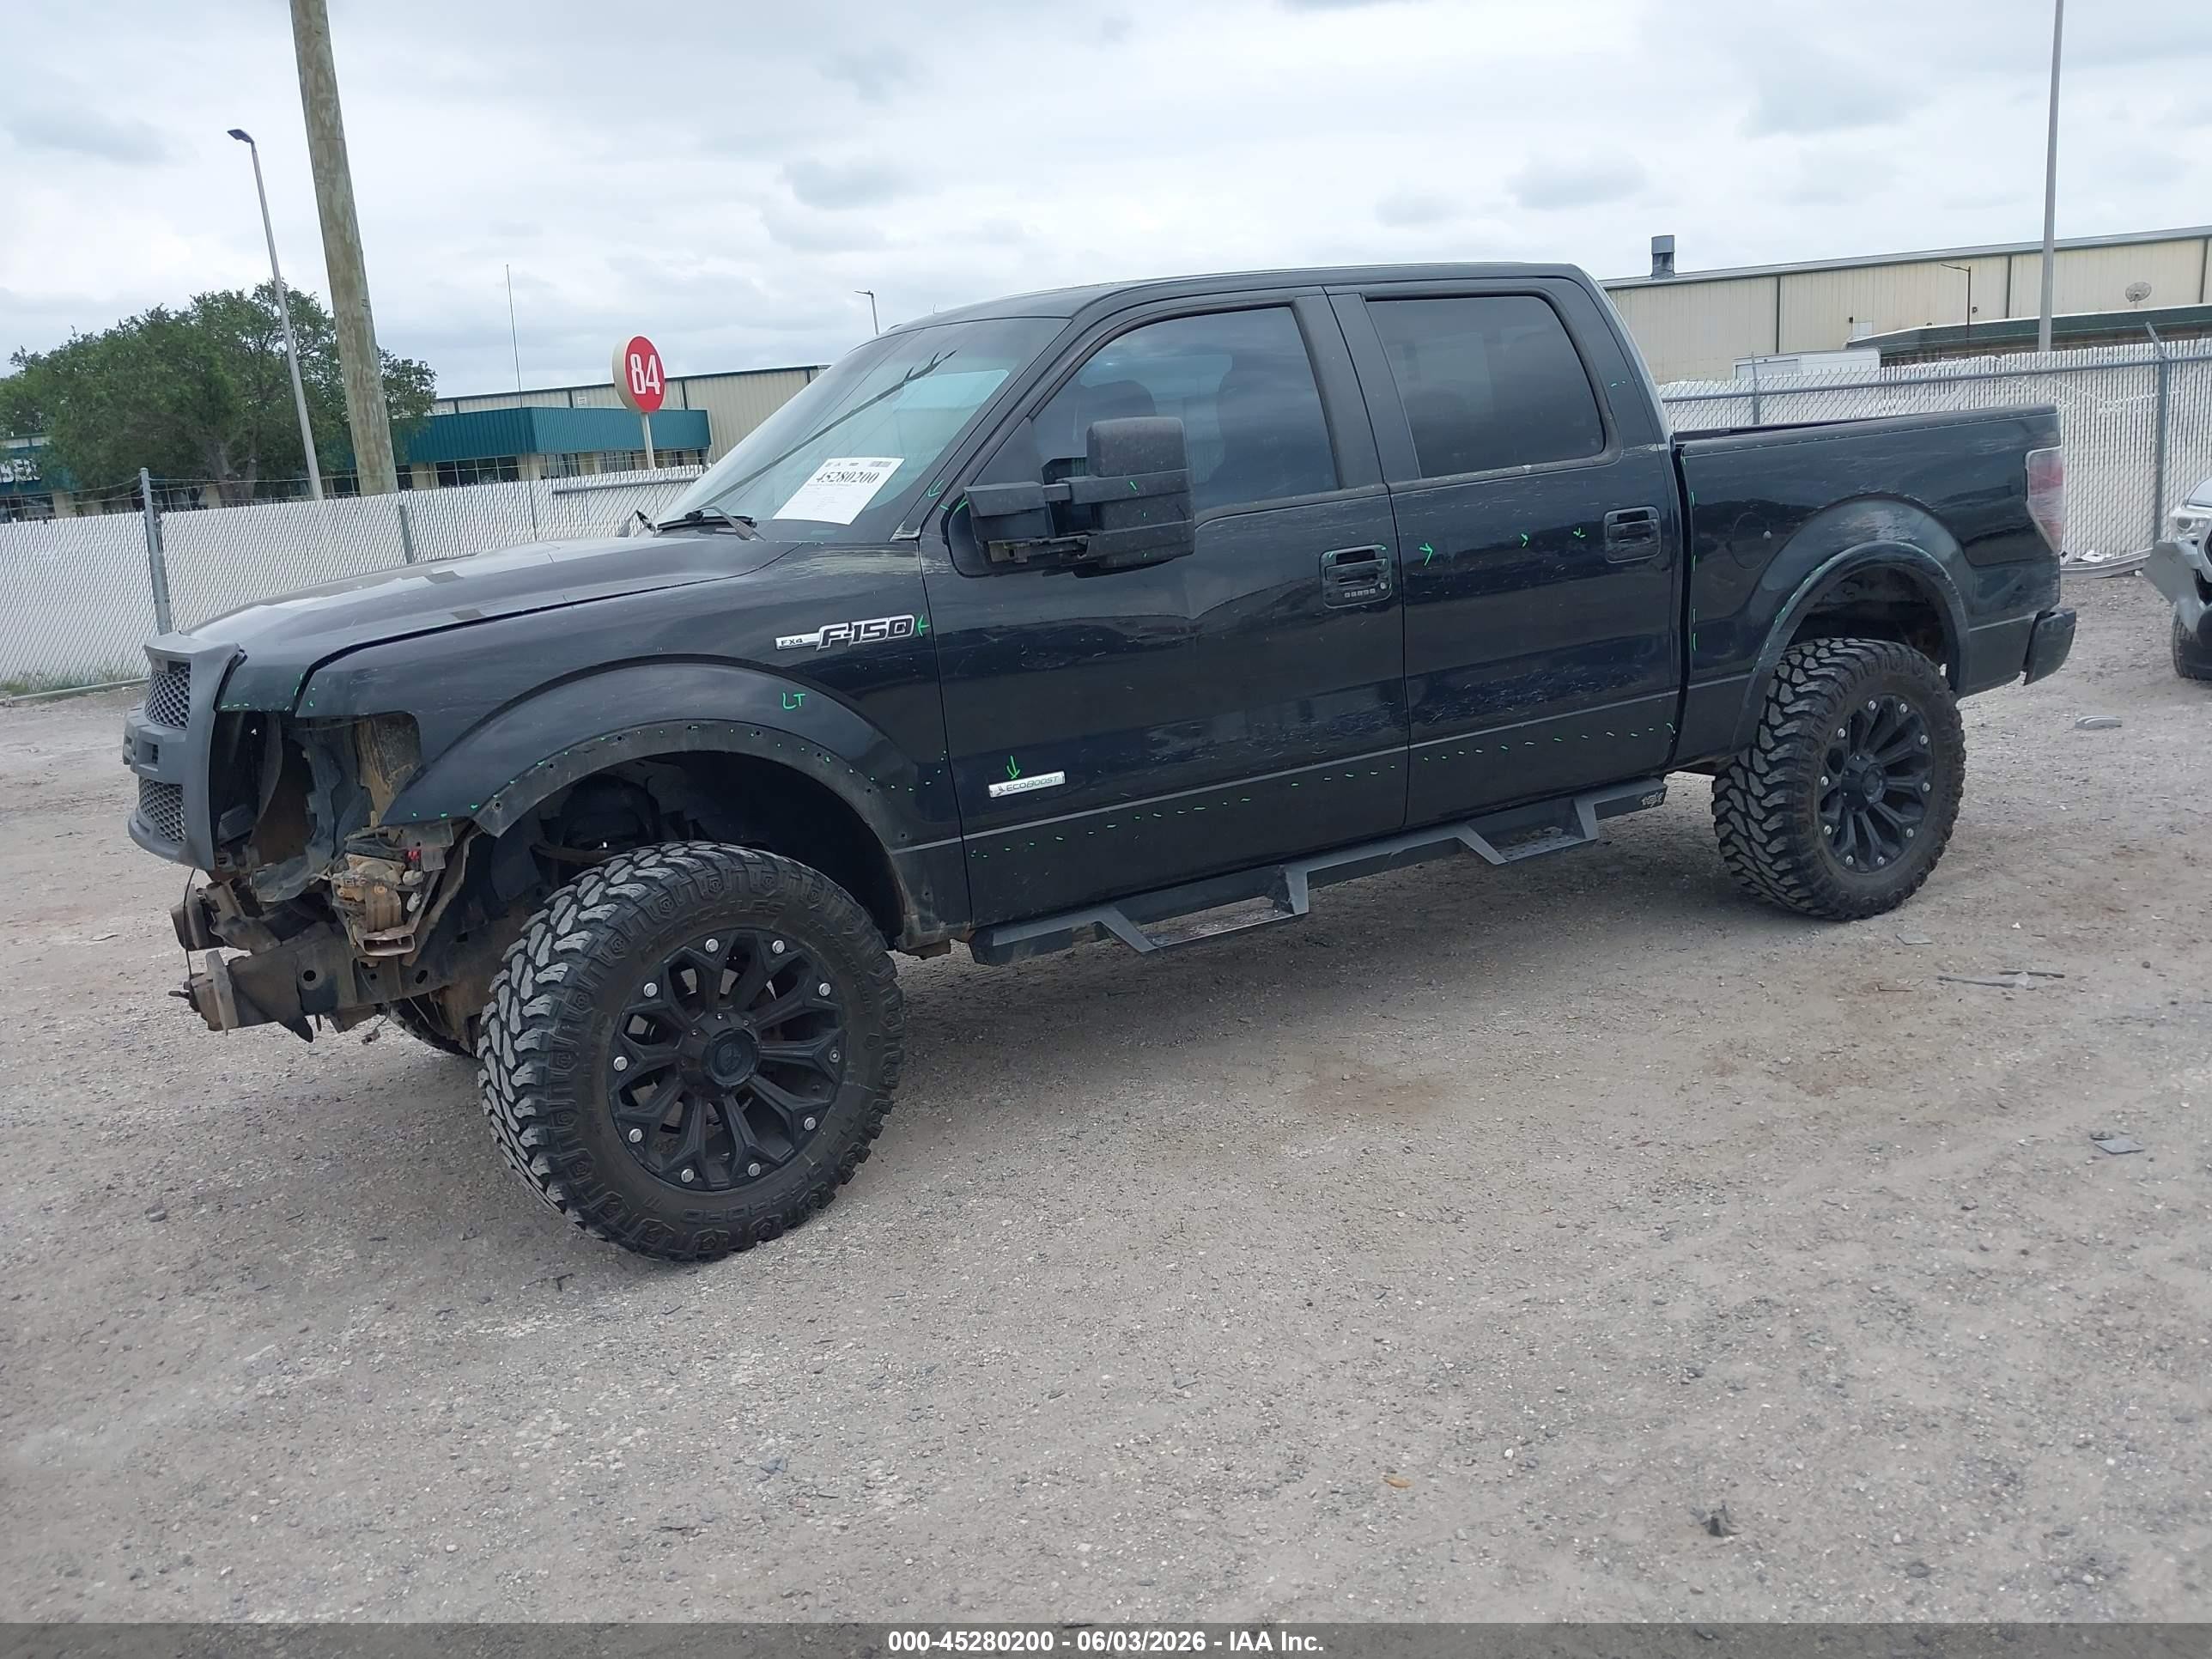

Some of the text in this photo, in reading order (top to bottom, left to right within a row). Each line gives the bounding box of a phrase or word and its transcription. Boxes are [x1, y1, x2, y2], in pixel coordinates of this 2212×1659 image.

[629, 353, 660, 395] 84
[816, 471, 880, 483] 45280200
[817, 614, 915, 651] F-150
[782, 692, 805, 709] LT
